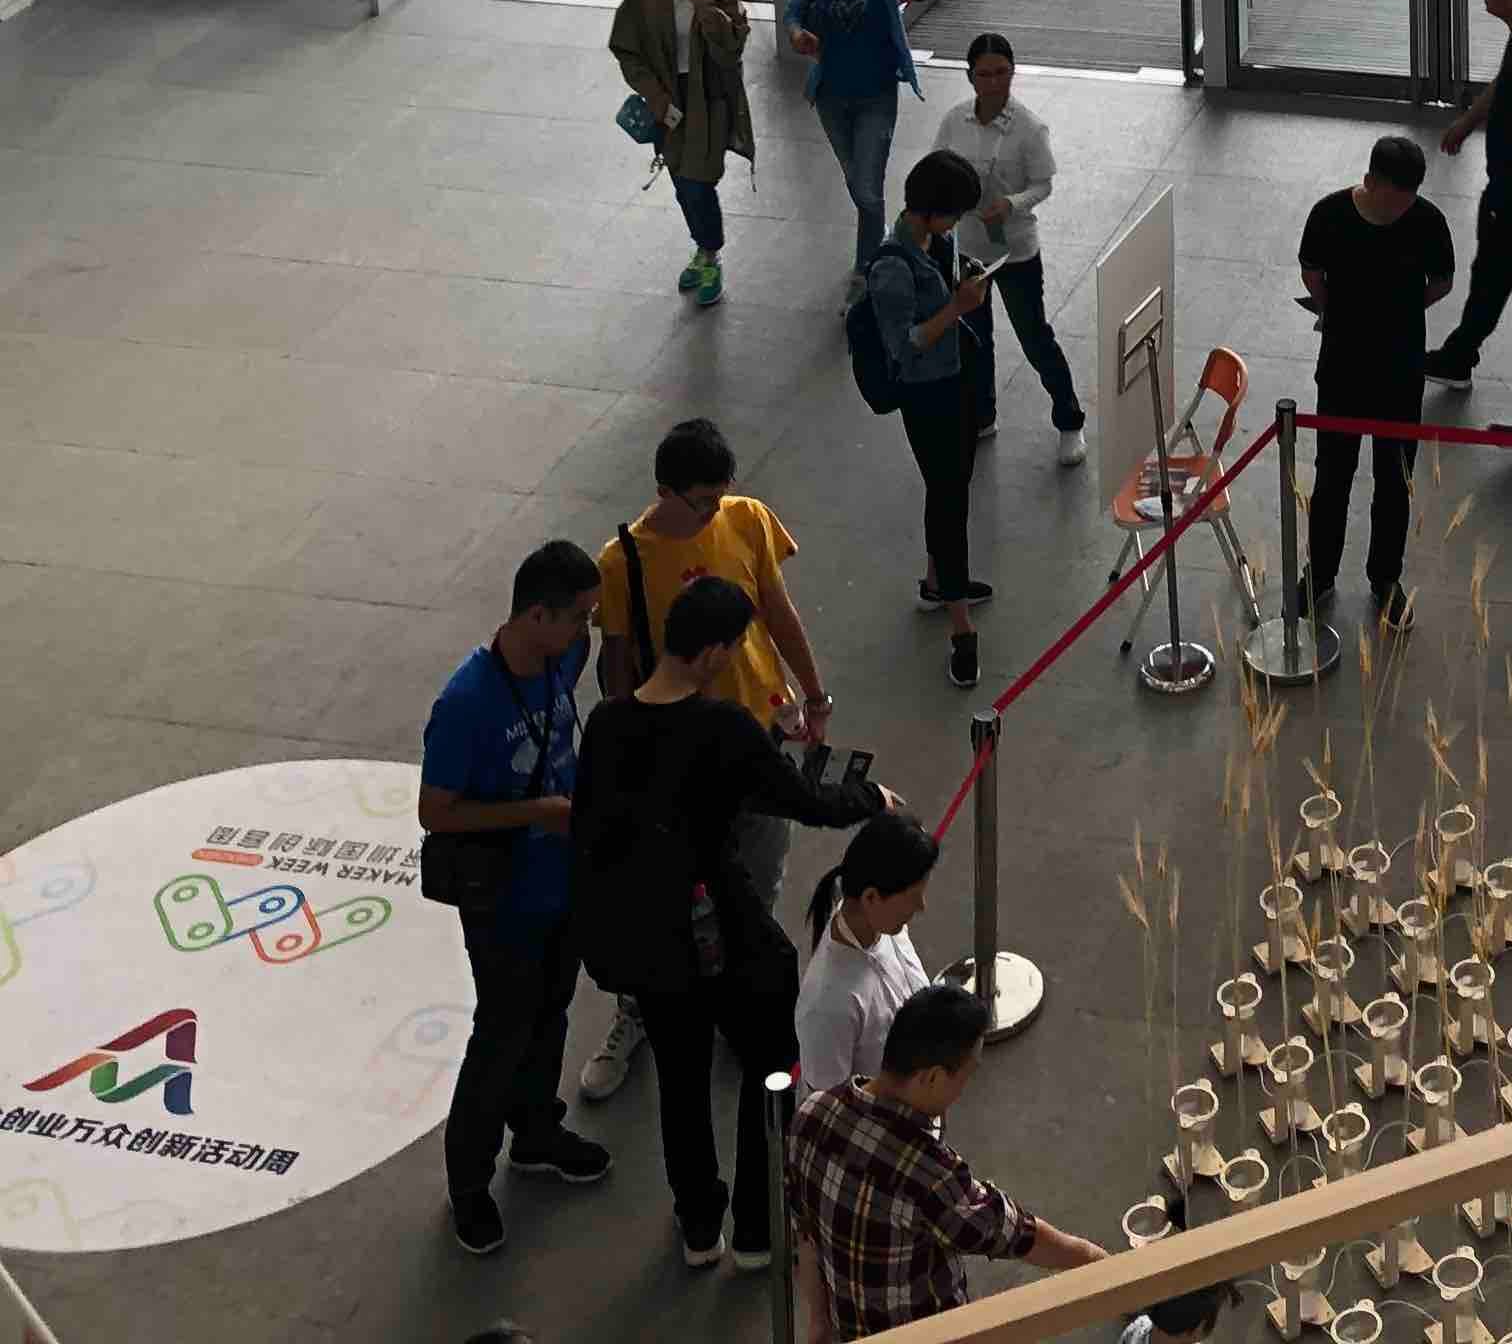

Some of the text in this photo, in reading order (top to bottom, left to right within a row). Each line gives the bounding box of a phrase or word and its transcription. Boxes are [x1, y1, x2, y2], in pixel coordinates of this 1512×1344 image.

[263, 855, 329, 877] WEEK
[336, 863, 418, 886] MAKER
[0, 1107, 300, 1175] 创业万众创新活动周
